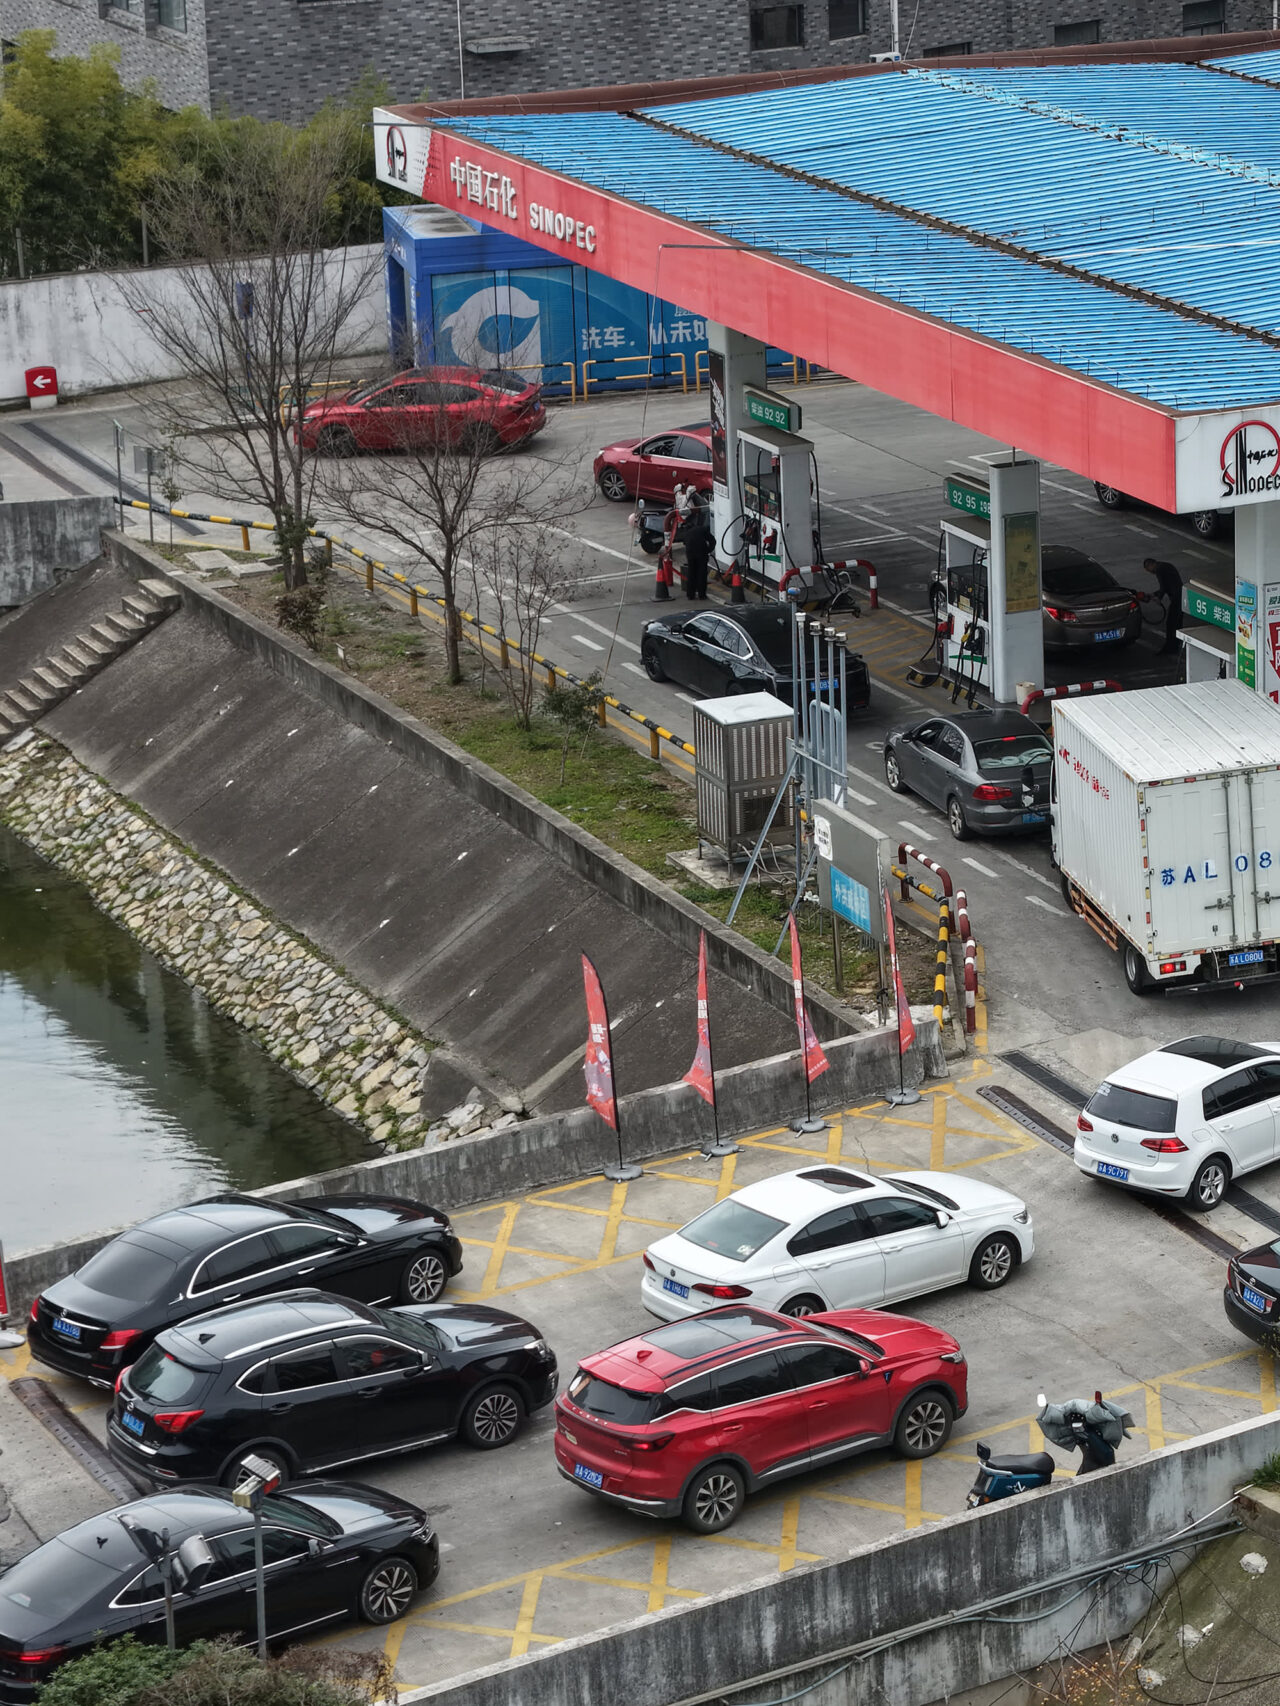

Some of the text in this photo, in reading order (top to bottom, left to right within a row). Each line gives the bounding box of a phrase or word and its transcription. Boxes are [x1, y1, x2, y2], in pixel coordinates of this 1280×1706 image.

[450, 156, 518, 220] 中国石化
[529, 202, 597, 253] SINOPEC
[765, 407, 774, 421] 92
[775, 411, 785, 424] 92
[952, 490, 963, 504] 92
[965, 495, 977, 509] 95
[1196, 600, 1231, 624] 95 柴油
